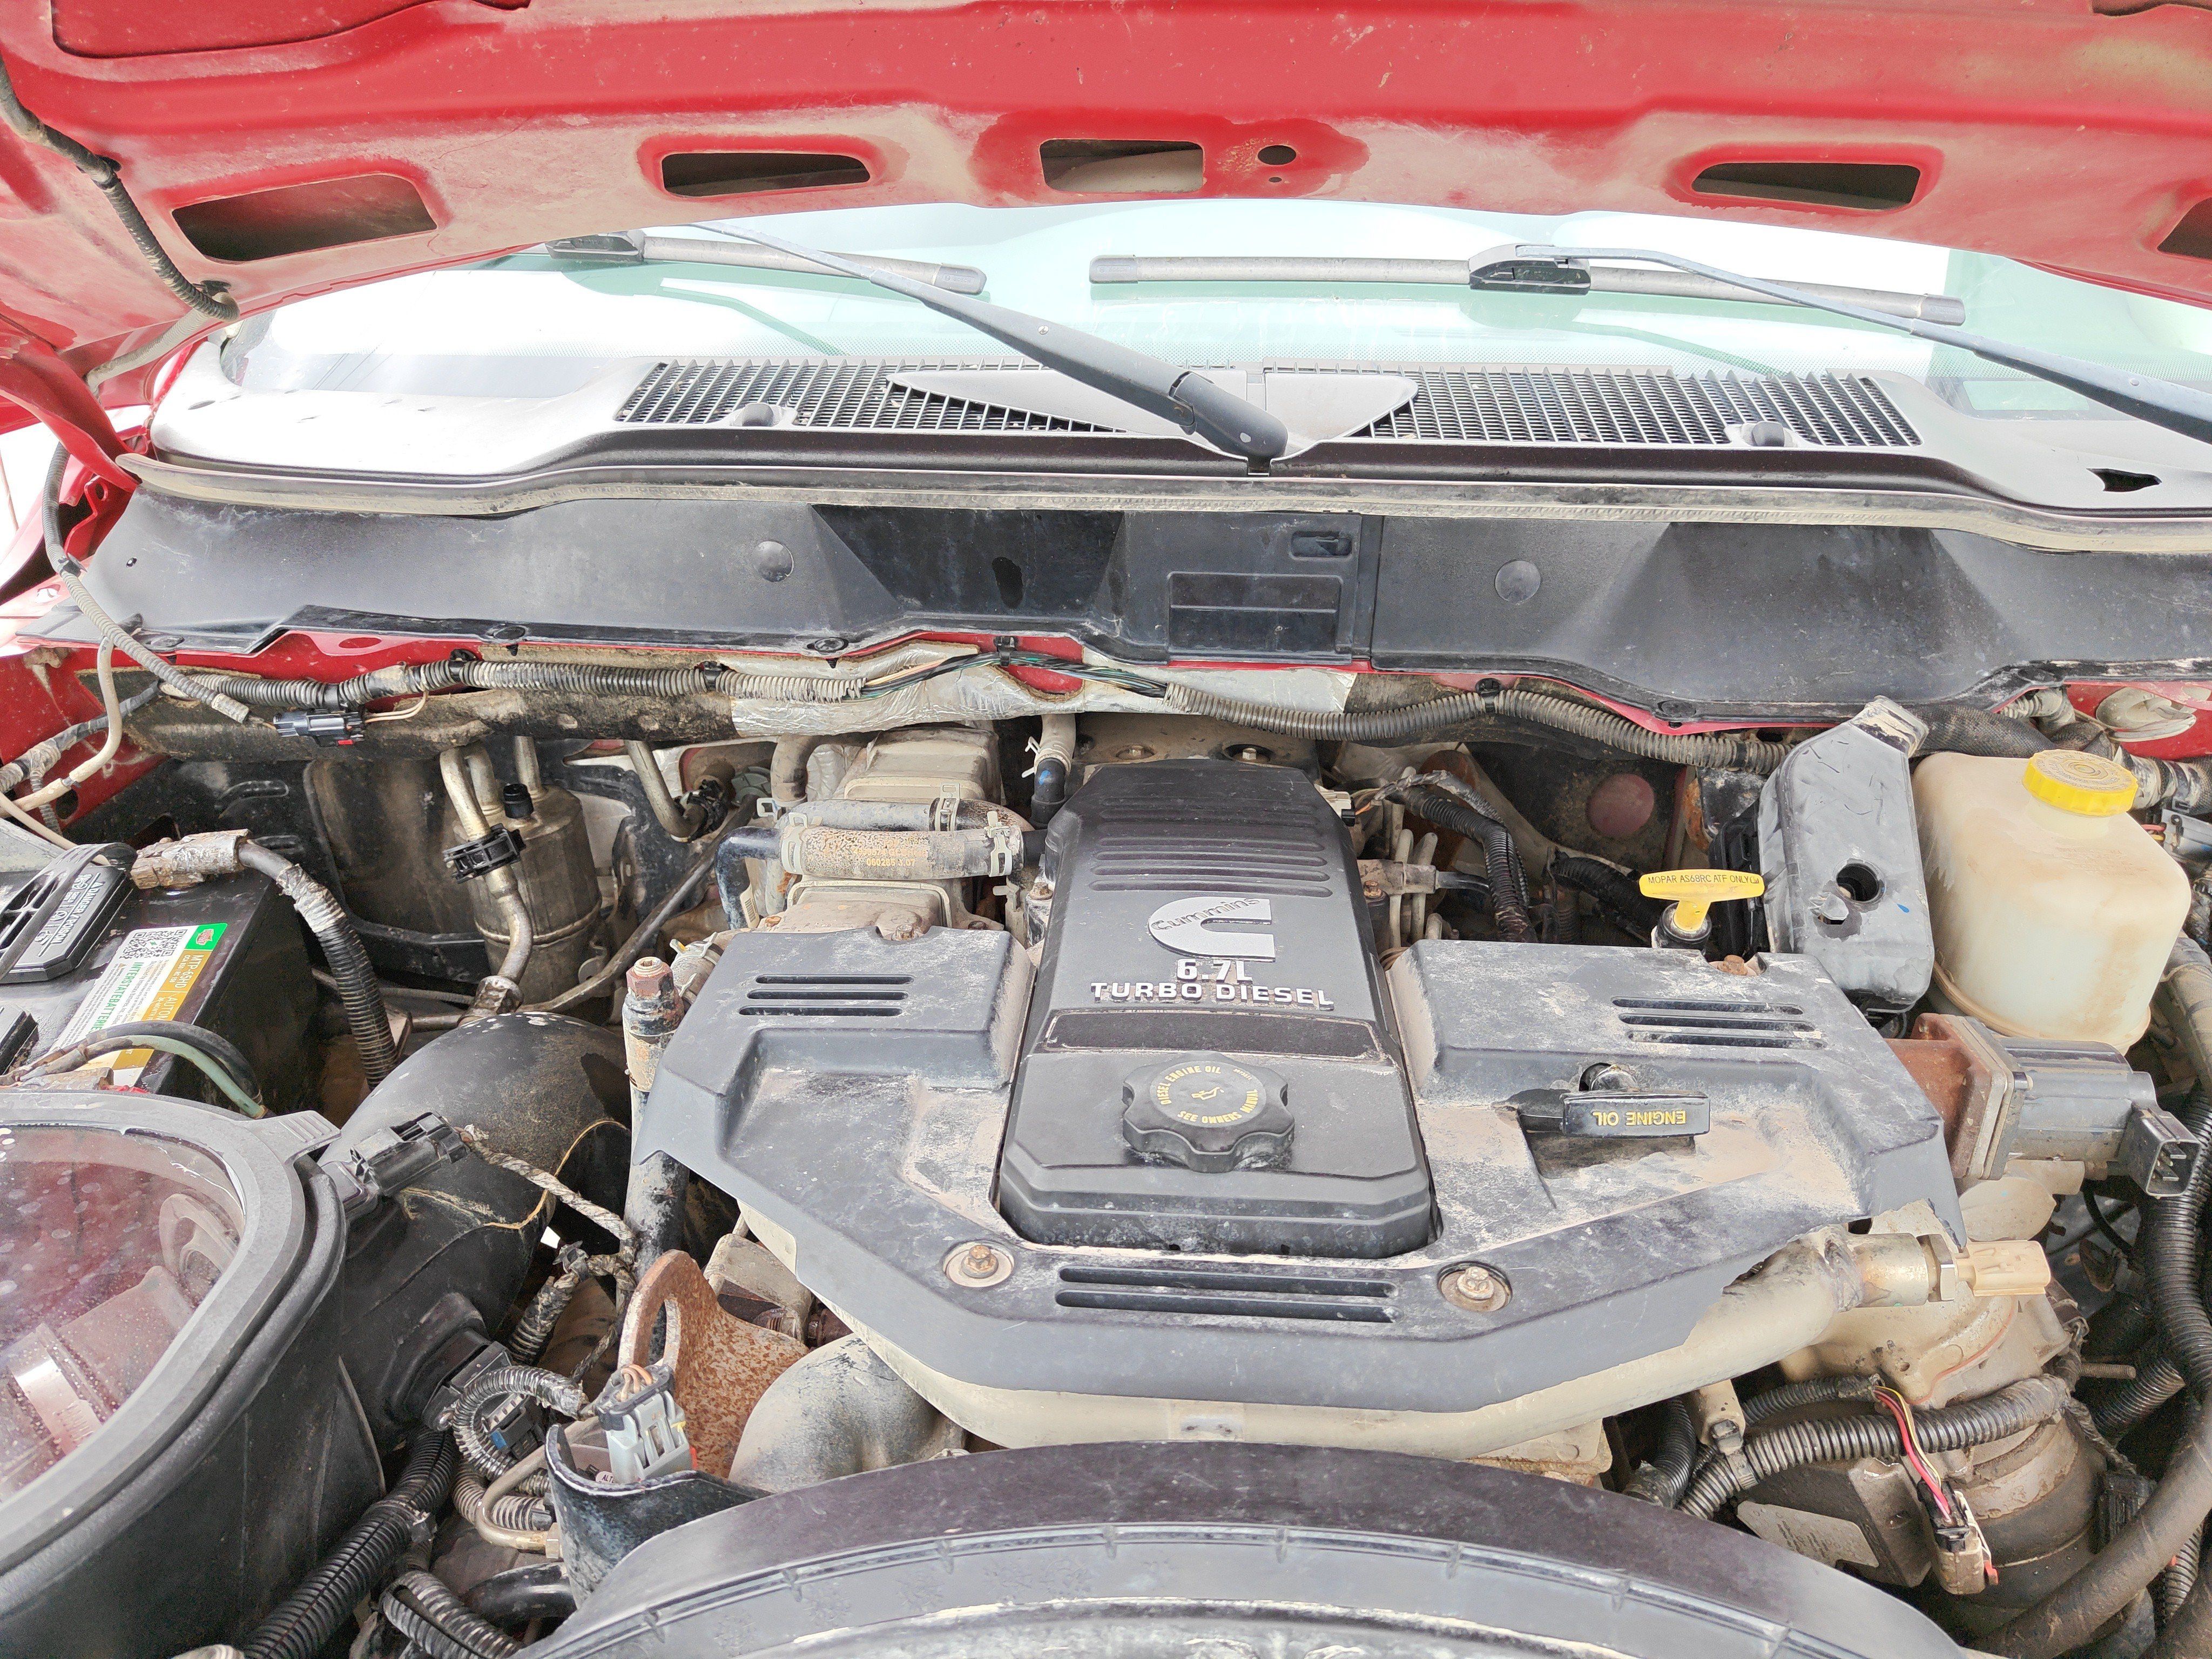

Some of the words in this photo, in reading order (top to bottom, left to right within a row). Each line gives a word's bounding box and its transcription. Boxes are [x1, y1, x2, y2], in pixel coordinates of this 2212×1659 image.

[866, 858, 896, 867] 060285
[1648, 875, 1677, 884] MOPAR
[1680, 874, 1711, 884] AS68RC
[1714, 875, 1727, 883] ATF
[1730, 875, 1749, 884] ONLY
[72, 888, 100, 914] DANGER
[1151, 898, 1260, 930] Cummins
[51, 919, 79, 944] POISON
[174, 955, 205, 988] MTP-65HD
[1176, 959, 1253, 984] 6.7L
[1091, 982, 1203, 1001] TURBO
[1215, 983, 1334, 1011] DIESEL
[1156, 1082, 1172, 1105] DIESEL
[1165, 1065, 1202, 1082] ENGINE
[1205, 1065, 1221, 1074] OIL
[1177, 1111, 1198, 1122] SEE
[1202, 1111, 1243, 1124] OWNERS
[1239, 1089, 1258, 1114] MANUAL
[1592, 1111, 1619, 1127] OIL
[1626, 1109, 1687, 1127] ENGINE
